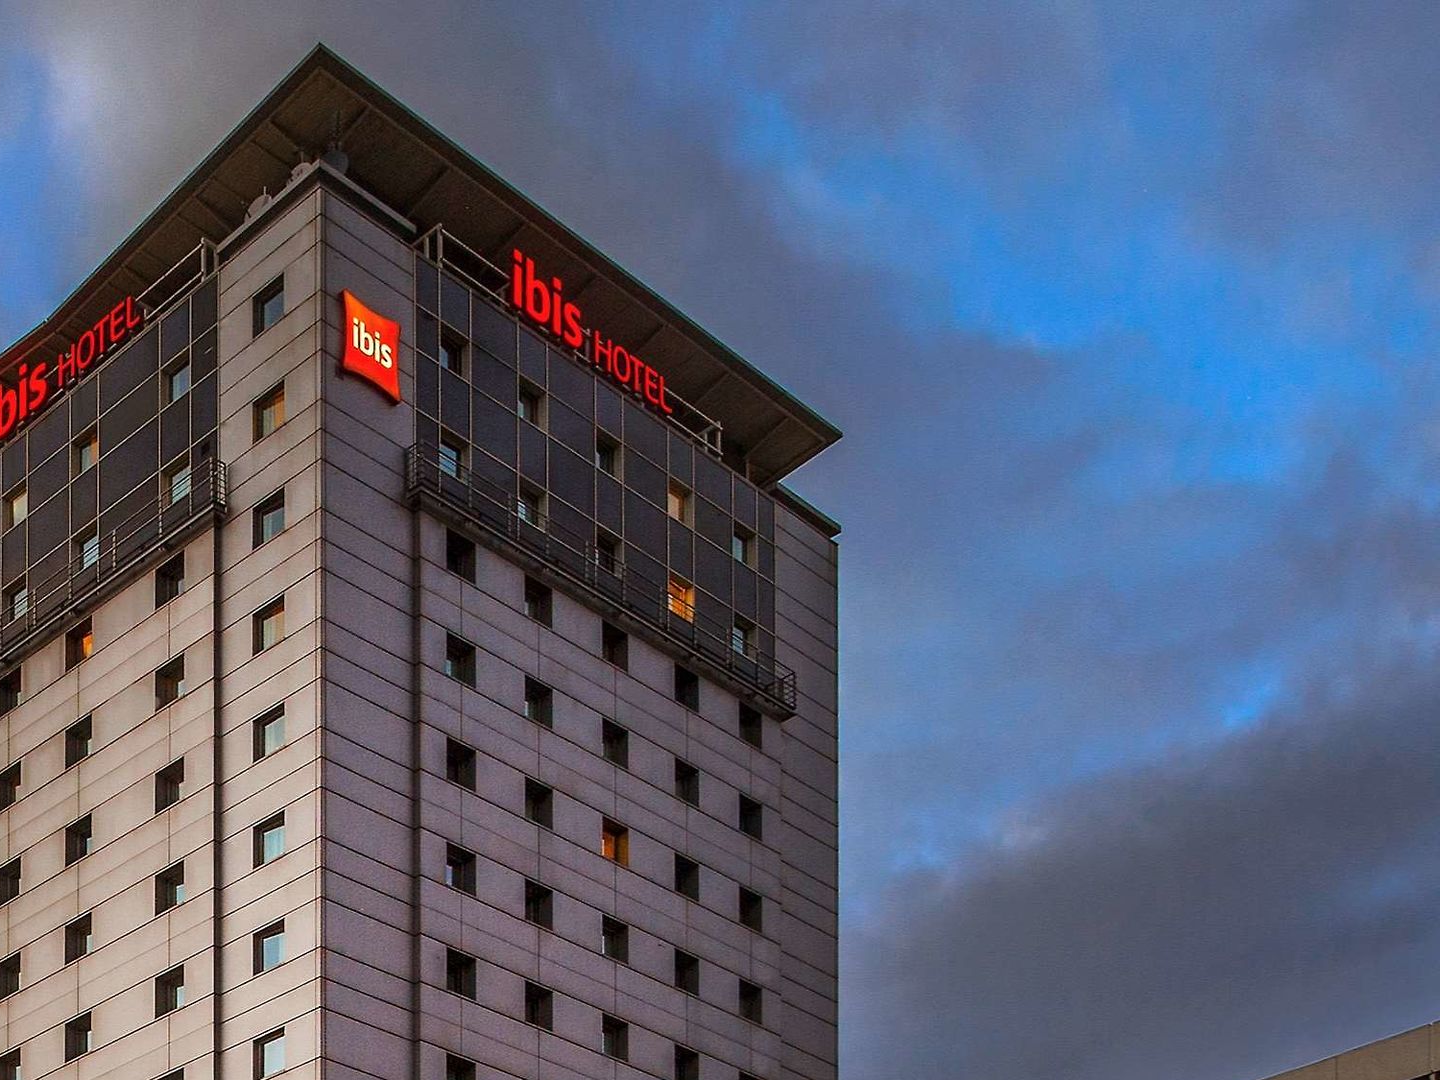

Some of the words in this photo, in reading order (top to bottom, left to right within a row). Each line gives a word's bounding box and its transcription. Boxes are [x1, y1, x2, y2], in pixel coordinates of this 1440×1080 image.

[58, 295, 141, 387] HOTEL
[352, 317, 393, 369] ibis
[513, 249, 584, 348] ibis
[594, 331, 673, 413] HOTEL
